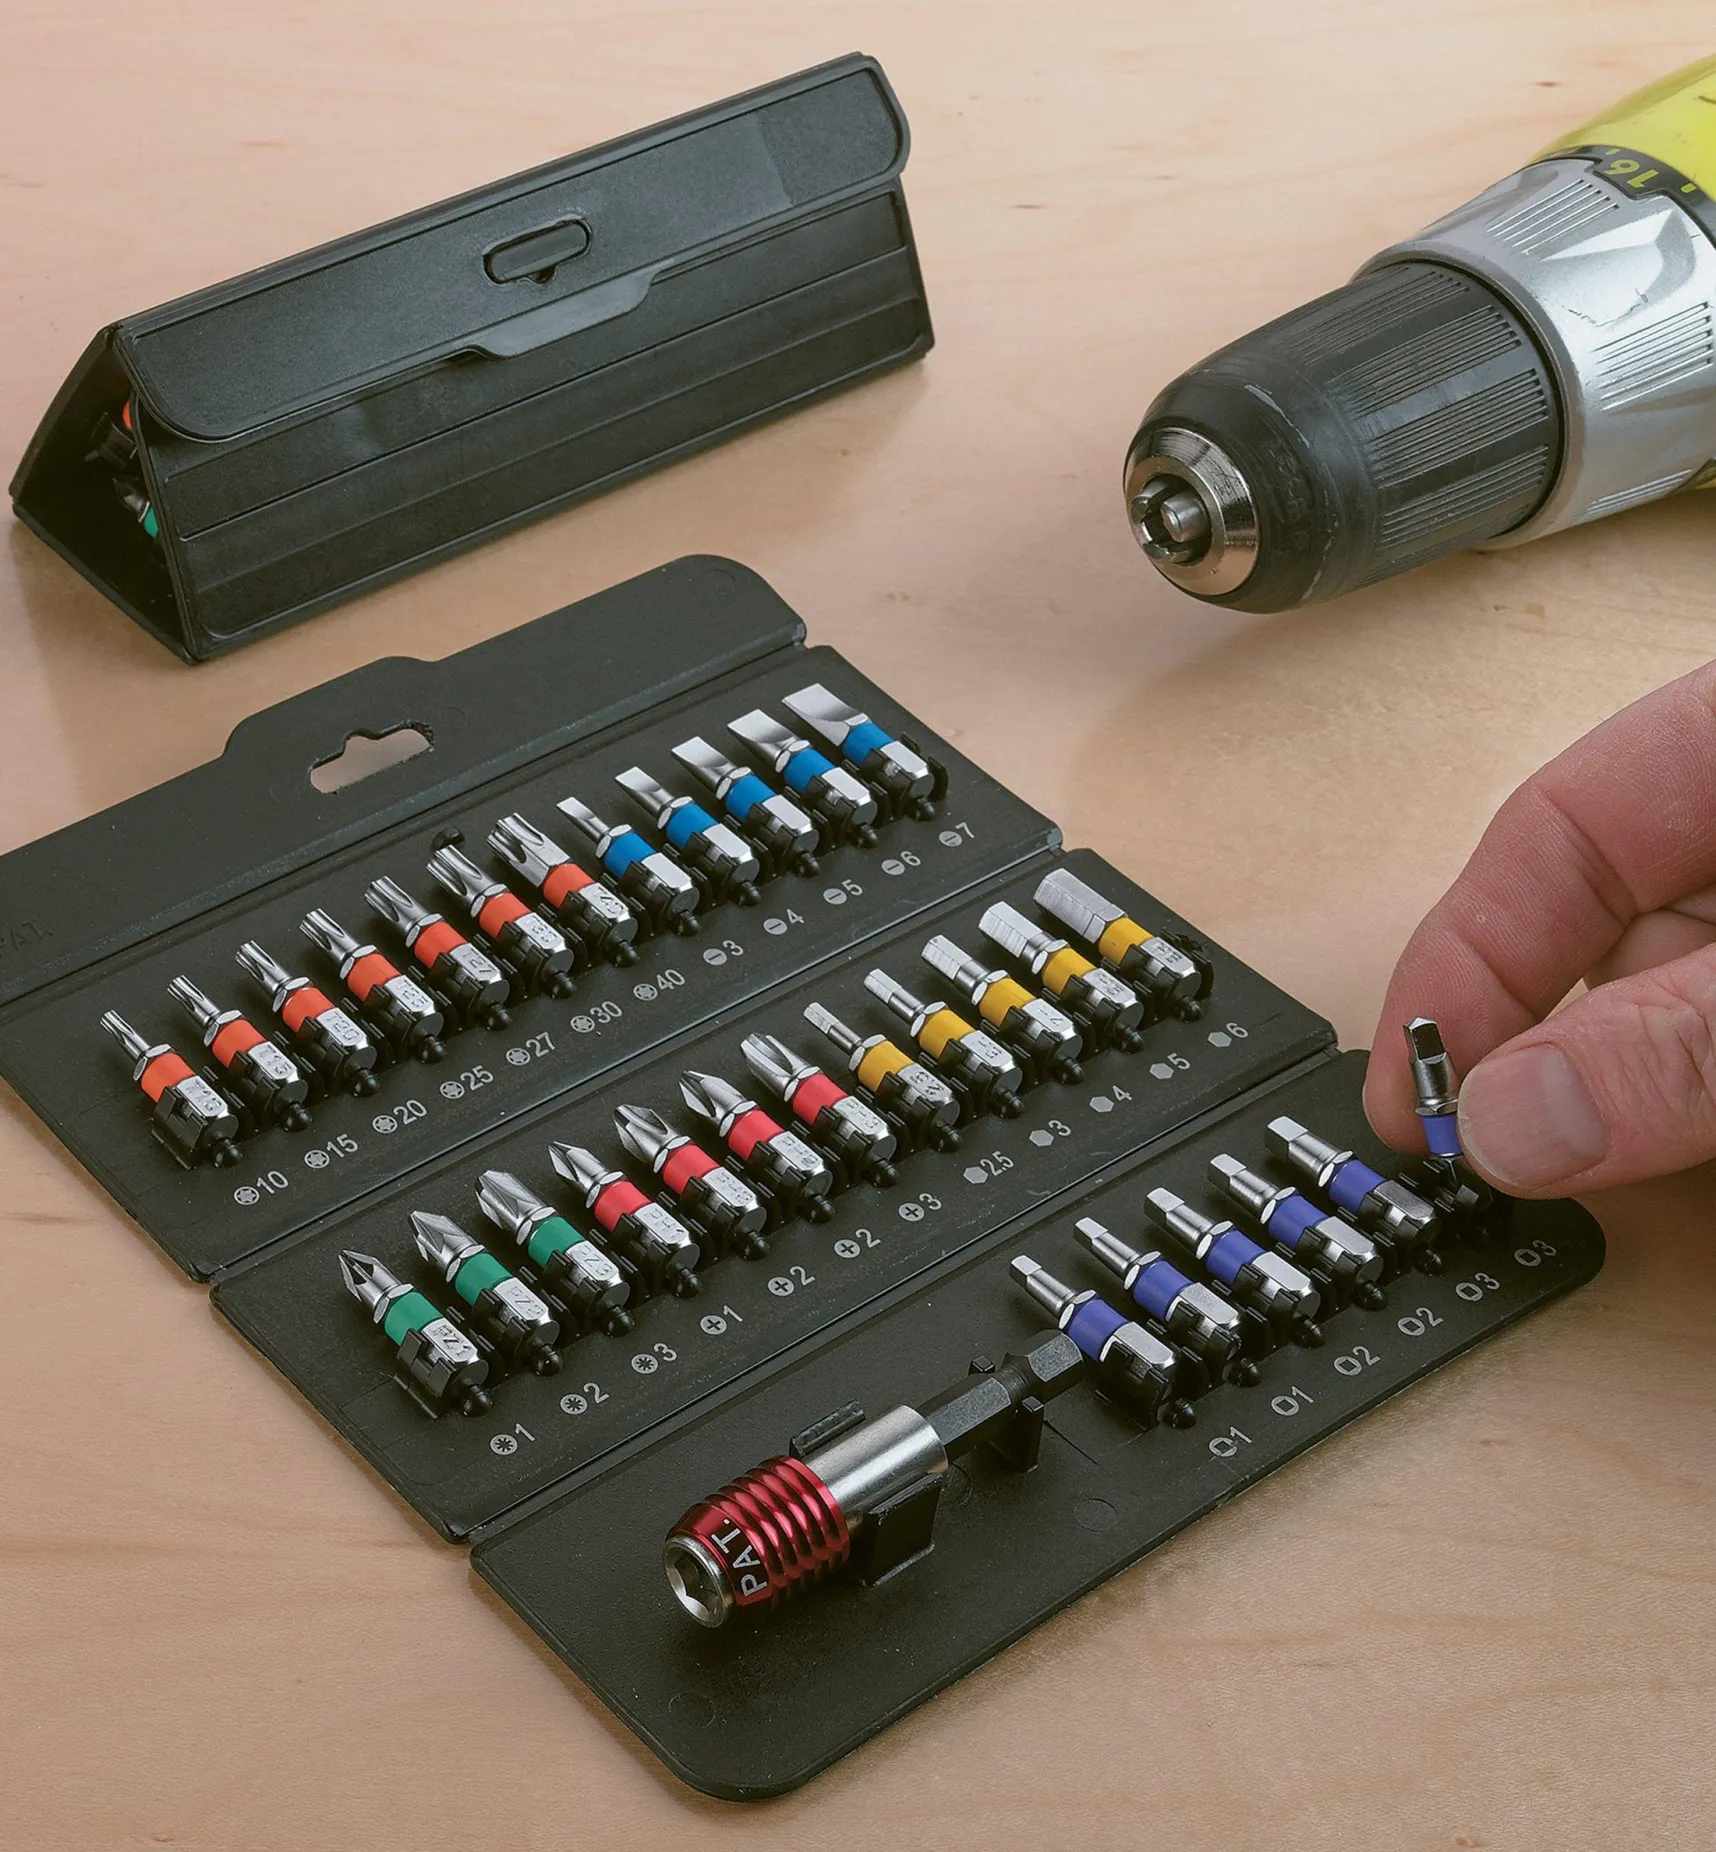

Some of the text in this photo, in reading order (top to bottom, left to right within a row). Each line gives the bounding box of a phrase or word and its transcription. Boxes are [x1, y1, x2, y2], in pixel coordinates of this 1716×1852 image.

[1604, 159, 1659, 188] 16
[955, 821, 975, 839] 7
[900, 850, 921, 867] 6
[842, 878, 863, 896] 5
[786, 908, 804, 926] 4
[722, 939, 744, 957] 3
[657, 969, 685, 992] 40
[590, 1001, 623, 1024] 30
[1225, 1022, 1249, 1039] 6
[525, 1031, 556, 1057] 27
[1167, 1052, 1191, 1071] 5
[460, 1065, 494, 1090] 25
[1112, 1084, 1133, 1102] 4
[393, 1099, 428, 1125] 20
[1048, 1119, 1071, 1138] 3
[326, 1133, 359, 1158] 15
[256, 1170, 289, 1195] 10
[919, 1192, 942, 1211] 3
[855, 1228, 882, 1248] 2
[1532, 1239, 1557, 1257] 3
[789, 1265, 816, 1286] 2
[1474, 1272, 1500, 1290] 3
[723, 1304, 743, 1323] 1
[1415, 1306, 1444, 1327] 2
[653, 1342, 678, 1362] 3
[1352, 1345, 1381, 1366] 2
[583, 1382, 610, 1404] 2
[1291, 1385, 1314, 1404] 1
[514, 1423, 536, 1442] 1
[1230, 1426, 1252, 1444] 1
[711, 1518, 768, 1597] PAT.
